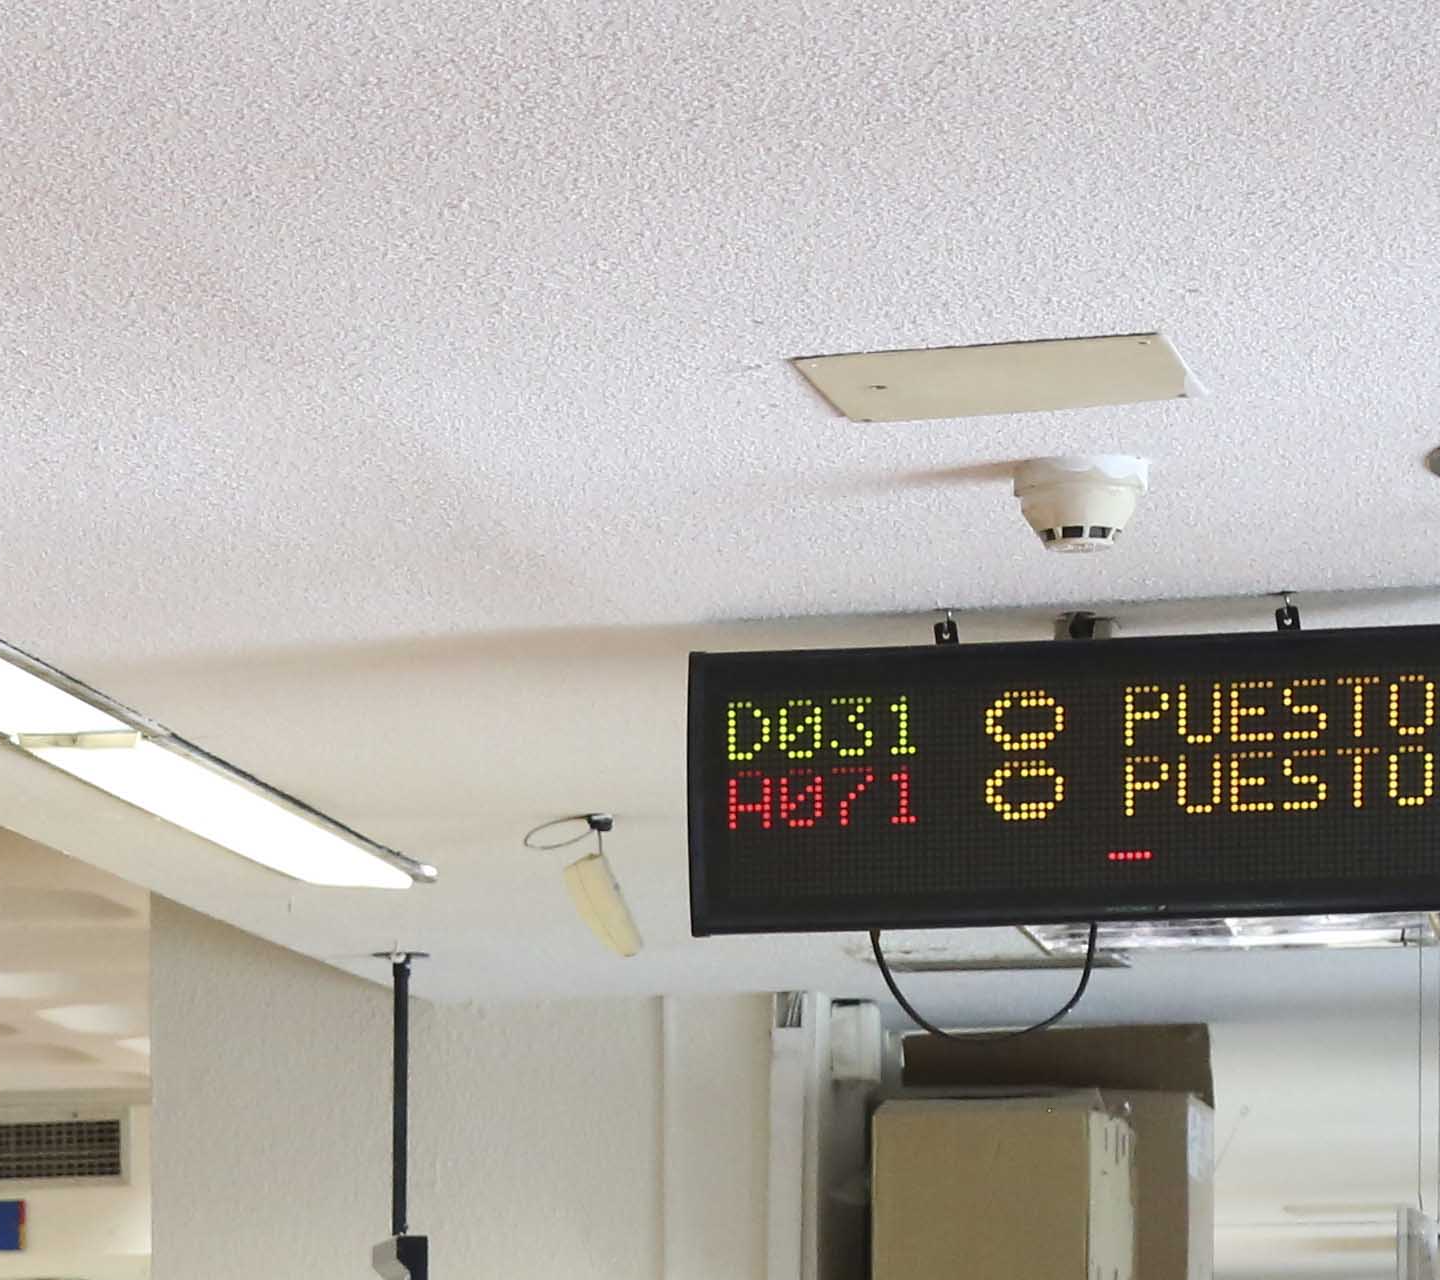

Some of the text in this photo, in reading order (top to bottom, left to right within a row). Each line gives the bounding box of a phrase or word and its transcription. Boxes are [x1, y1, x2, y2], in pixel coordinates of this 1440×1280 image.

[727, 695, 917, 761] D031
[1124, 674, 1435, 748] PUESTO
[727, 766, 917, 830] A071
[1124, 746, 1435, 818] PUESTO
